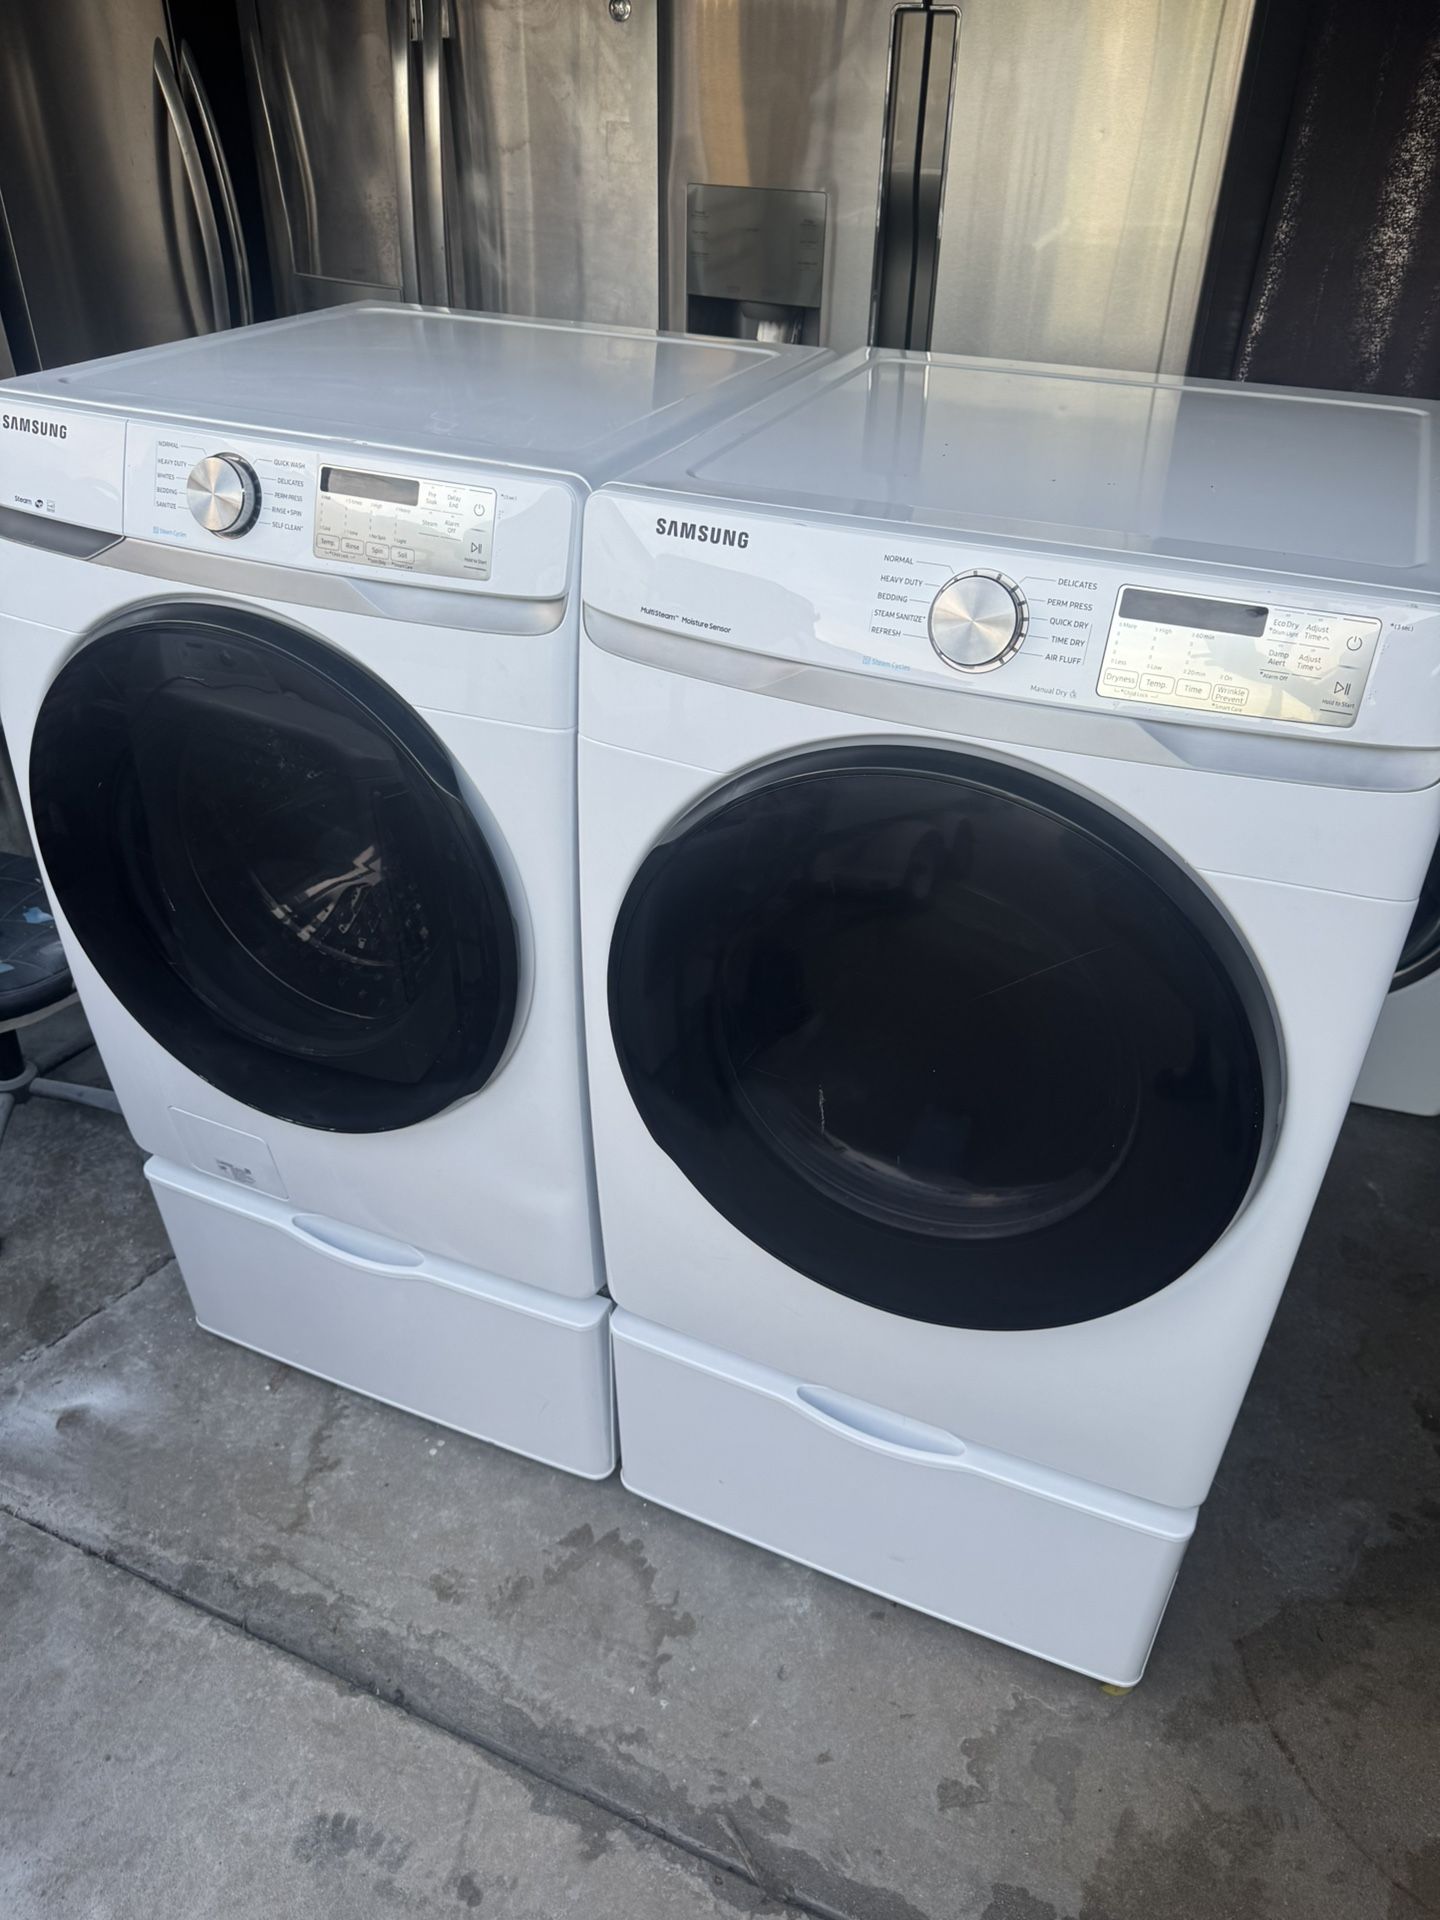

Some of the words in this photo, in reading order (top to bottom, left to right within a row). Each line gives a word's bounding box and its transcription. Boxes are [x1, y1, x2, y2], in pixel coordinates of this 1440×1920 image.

[2, 414, 68, 440] SAMSUNG
[158, 441, 179, 449] NORMAL
[174, 460, 187, 468] DUTY
[273, 459, 289, 467] QUICK
[277, 477, 304, 487] DELICATES
[288, 494, 303, 502] PRESS
[272, 521, 284, 529] SELF
[655, 518, 750, 549] SAMSUNG
[883, 554, 914, 565] NORMAL
[880, 574, 904, 584] HEAVY
[904, 577, 924, 587] DUTY
[1057, 578, 1098, 591] DELICATES
[877, 592, 908, 603] BEDDING
[1047, 598, 1068, 608] PERM
[1069, 601, 1093, 611] PRESS
[873, 609, 895, 619] STEAM
[681, 616, 709, 628] Moisture
[709, 623, 732, 634] Sensor
[1049, 617, 1073, 628] QUICK
[1073, 621, 1089, 630] DRY
[1273, 618, 1286, 628] Eco
[1286, 621, 1300, 630] Dry
[1306, 623, 1330, 635] Adjust
[870, 626, 902, 637] REFRESH
[1304, 632, 1322, 641] Time
[1051, 635, 1069, 645] TIME
[1069, 639, 1086, 648] DRY
[1044, 653, 1058, 661] AIR
[1059, 655, 1081, 665] FLUFF
[1268, 649, 1289, 660] Damp
[1298, 654, 1322, 665] Adjust
[1267, 658, 1286, 667] Alert
[1297, 663, 1314, 672] Time
[1106, 672, 1136, 686] Dryness
[1262, 673, 1279, 681] Alarm
[1146, 679, 1168, 690] Temp.
[1184, 684, 1203, 695] Time
[1030, 684, 1055, 696] Manual
[1056, 688, 1068, 698] Dry
[1217, 686, 1245, 697] Wrinkle
[1215, 693, 1244, 704] Prevent
[1341, 701, 1355, 709] Start
